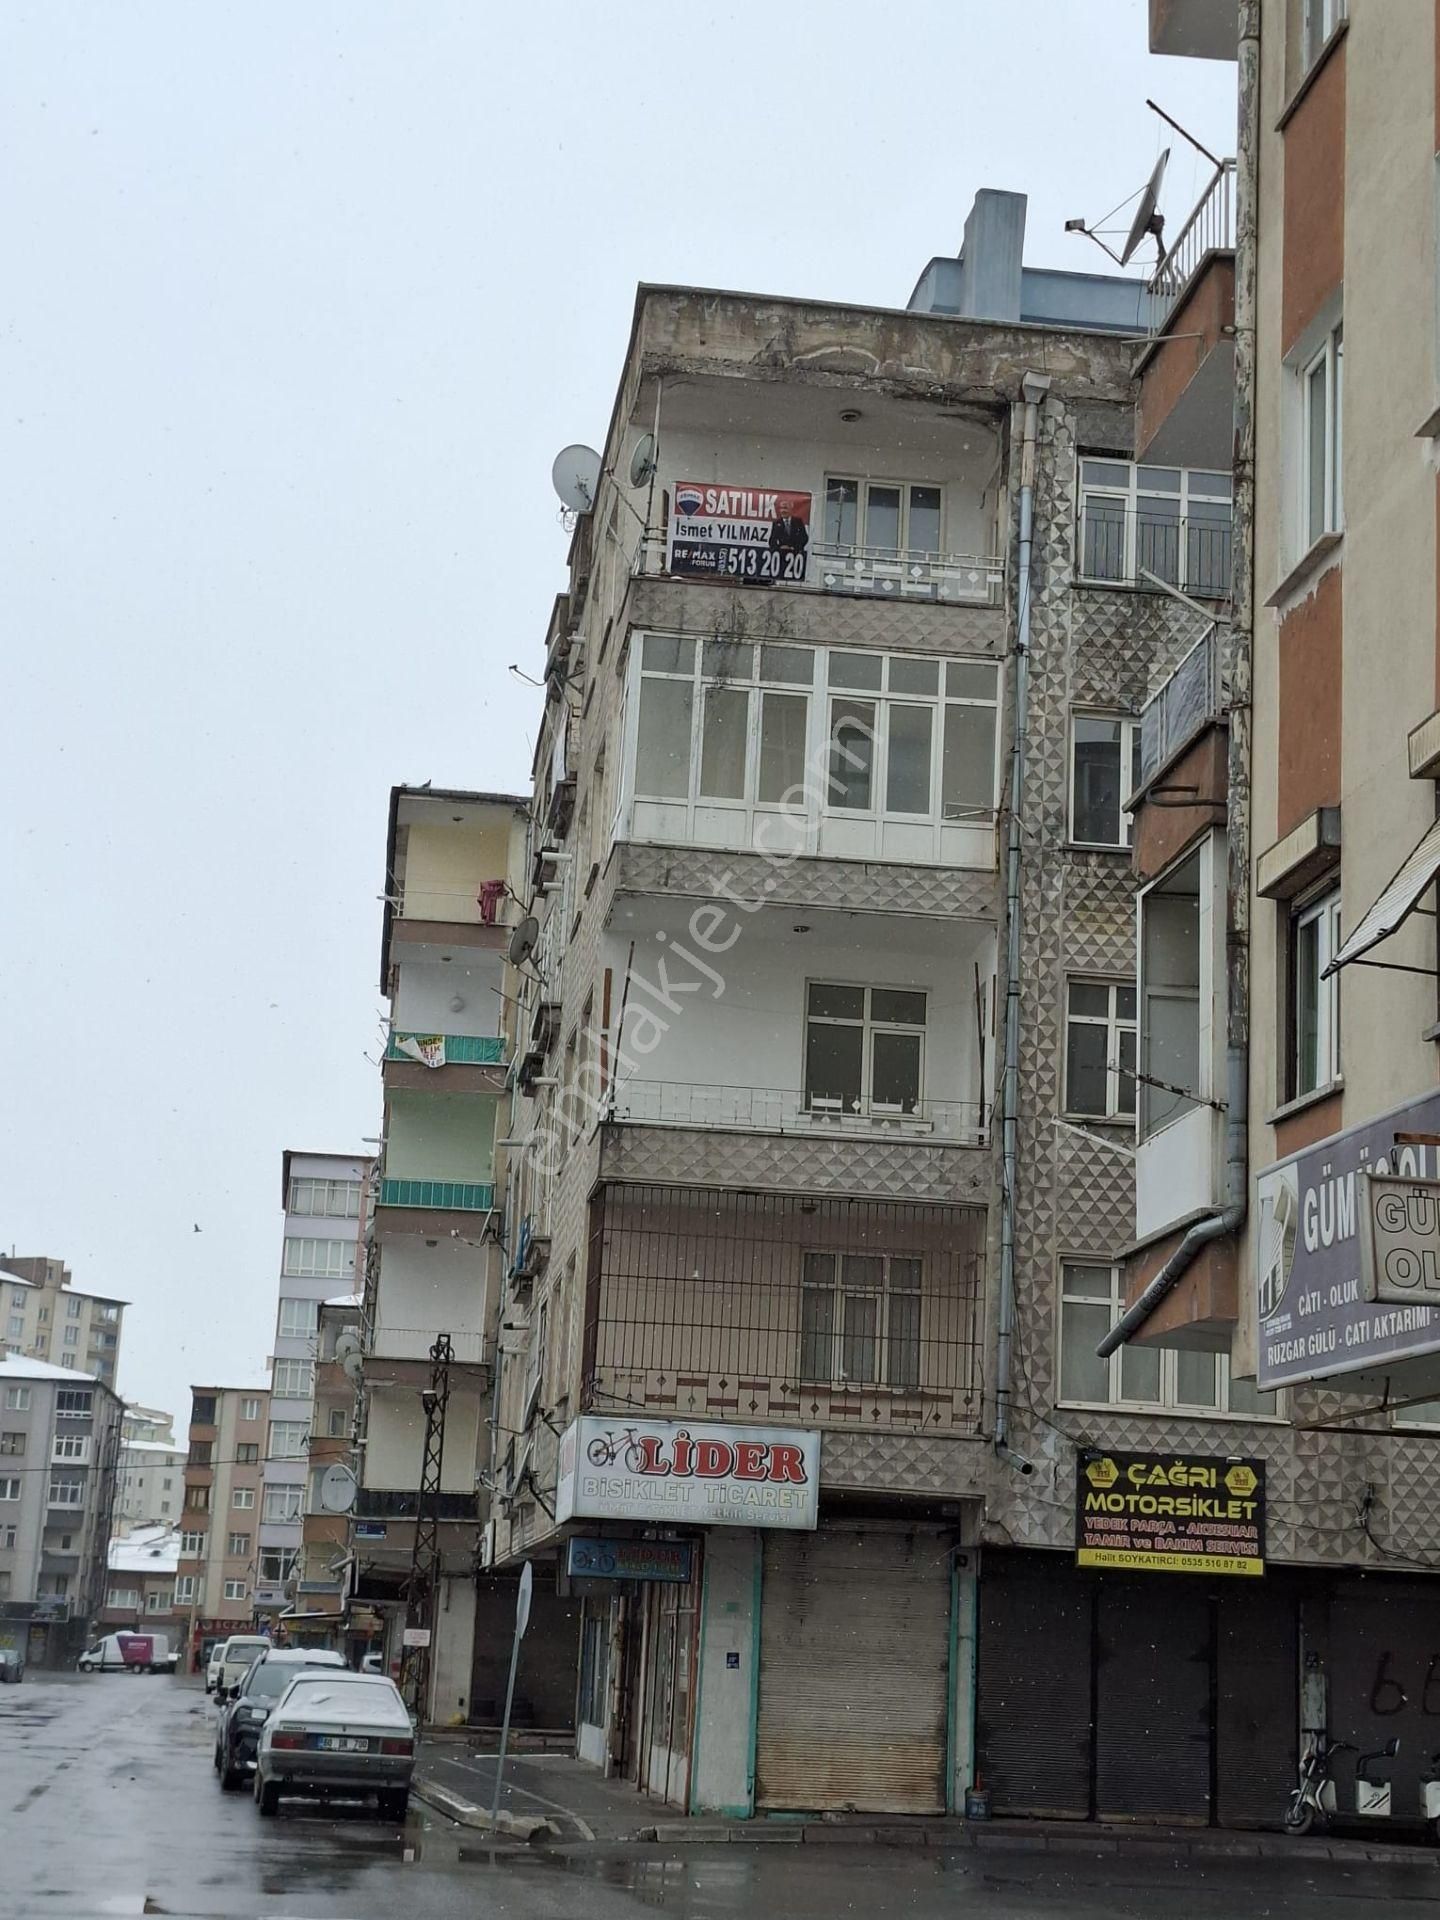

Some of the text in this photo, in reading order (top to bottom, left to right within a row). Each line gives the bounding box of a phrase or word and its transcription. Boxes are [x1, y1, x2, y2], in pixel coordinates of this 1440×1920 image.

[706, 489, 778, 519] SATILIK
[717, 523, 769, 543] YILMAZ
[674, 549, 716, 561] RE/MAX
[691, 560, 716, 568] FORUM
[728, 547, 804, 579] 513 20 20
[1375, 1188, 1440, 1235] GÜ
[1329, 1279, 1359, 1308] OLUK
[1267, 1337, 1306, 1367] RÜZGAR
[1308, 1325, 1336, 1356] GÜLÜ
[1373, 1306, 1430, 1340] AKTARIMI
[636, 1429, 809, 1485] LİDER
[1127, 1460, 1217, 1491] ÇAĞRI
[1084, 1493, 1258, 1520] MOTORSİKLET
[1084, 1516, 1128, 1531] YEDEK
[1130, 1519, 1176, 1536] PARÇA
[1186, 1523, 1259, 1540] AKSESUAR
[1134, 1538, 1152, 1549] ve
[1154, 1537, 1204, 1552] BAKIM
